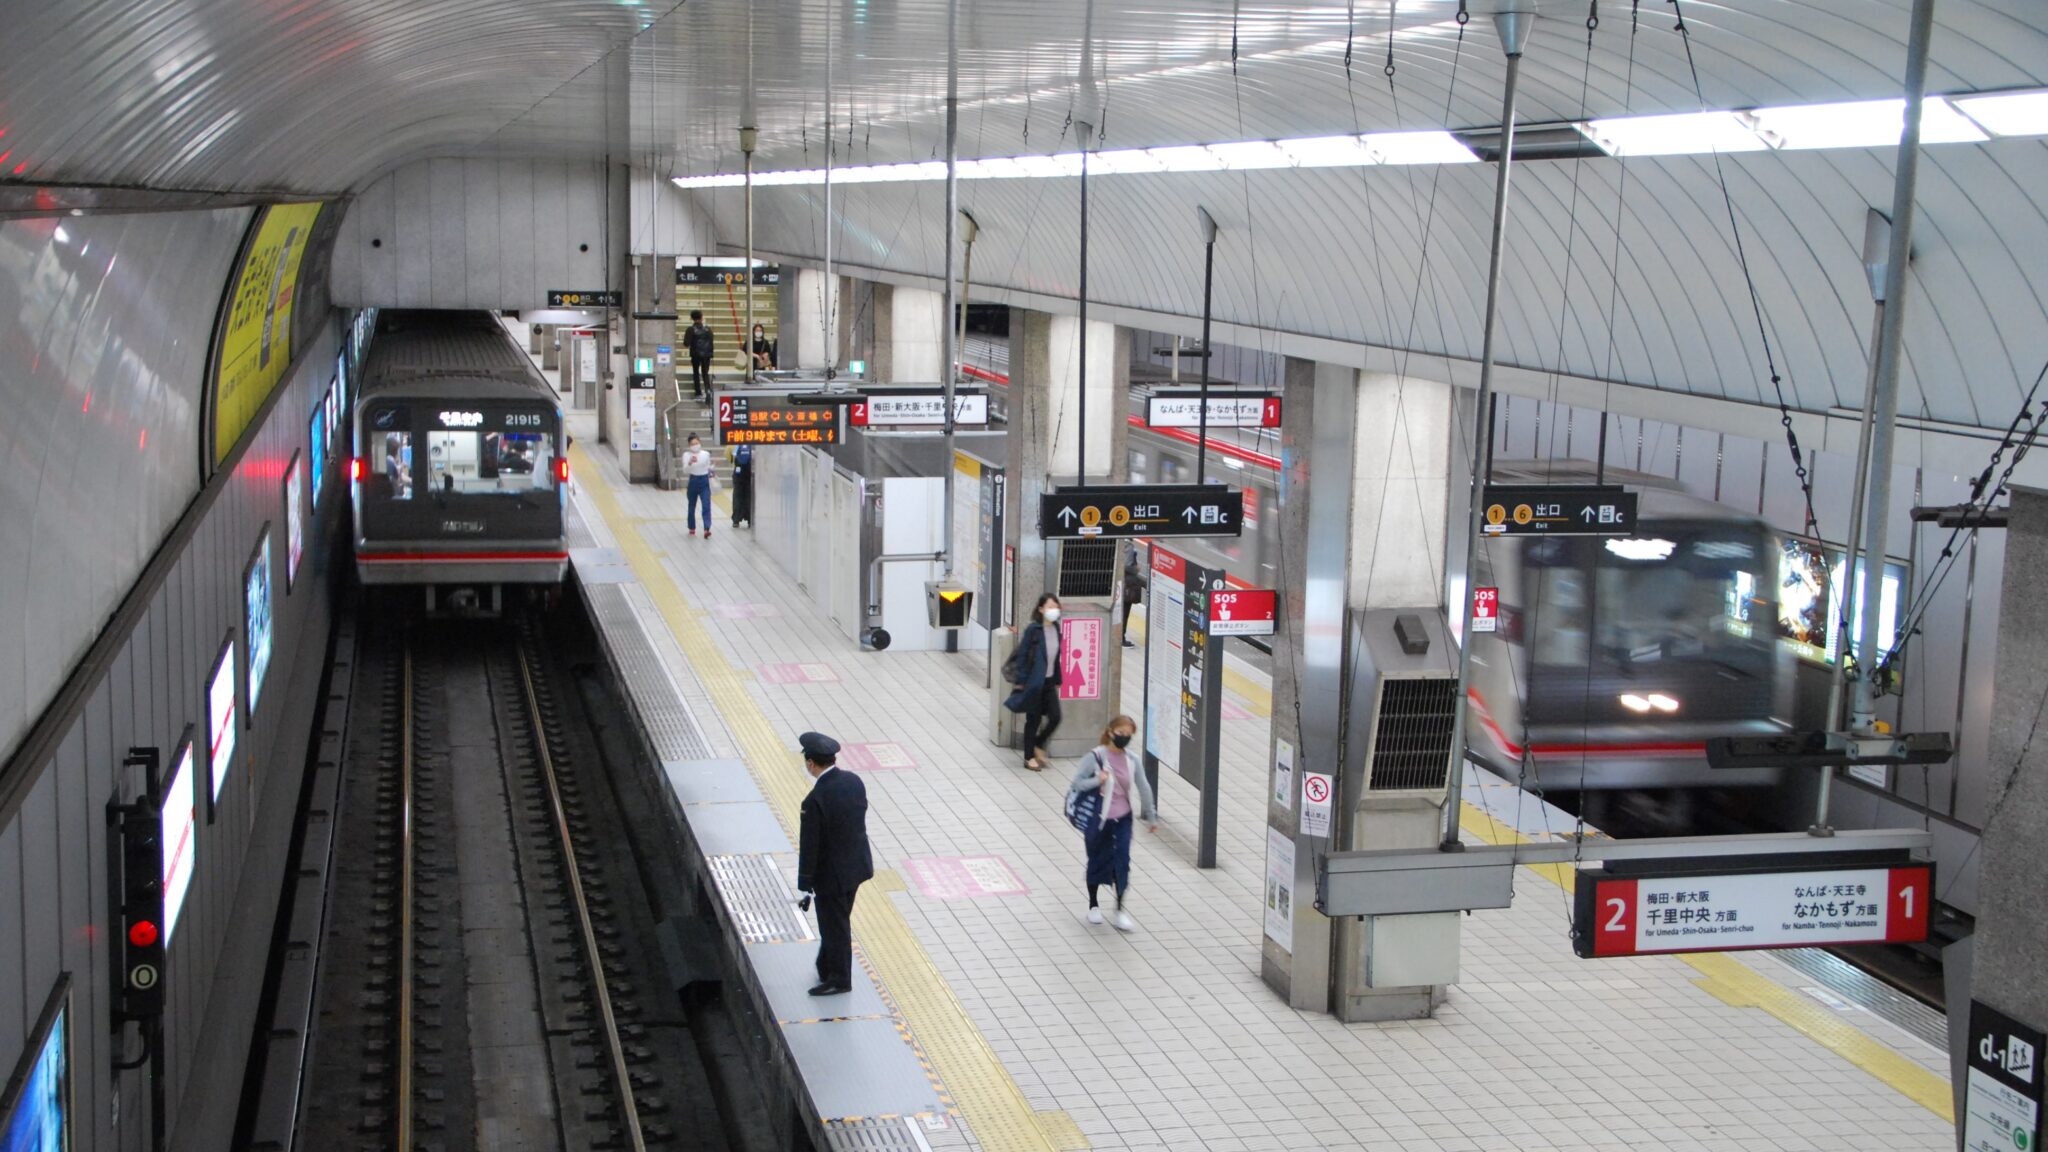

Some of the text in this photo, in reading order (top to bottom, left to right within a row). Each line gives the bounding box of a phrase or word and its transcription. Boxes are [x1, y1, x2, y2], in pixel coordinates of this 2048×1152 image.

[721, 402, 731, 422] 2
[855, 403, 864, 417] 2
[1267, 404, 1275, 418] 1
[506, 415, 540, 425] 21915
[1087, 511, 1093, 521] 1
[1115, 511, 1123, 521] 6
[1133, 505, 1160, 518] 出口
[1492, 509, 1499, 520] 1
[1519, 509, 1526, 520] 6
[1536, 504, 1560, 516] 出口
[1214, 593, 1237, 603] SOS
[1266, 611, 1272, 619] 2
[1647, 890, 1710, 905] 梅田・新大阪
[1794, 884, 1866, 898] なんば・天王寺
[1899, 885, 1914, 919] 1
[1604, 897, 1626, 932] 2
[1645, 928, 1655, 937] for
[1781, 921, 1792, 931] for
[1979, 1033, 2006, 1070] d-1
